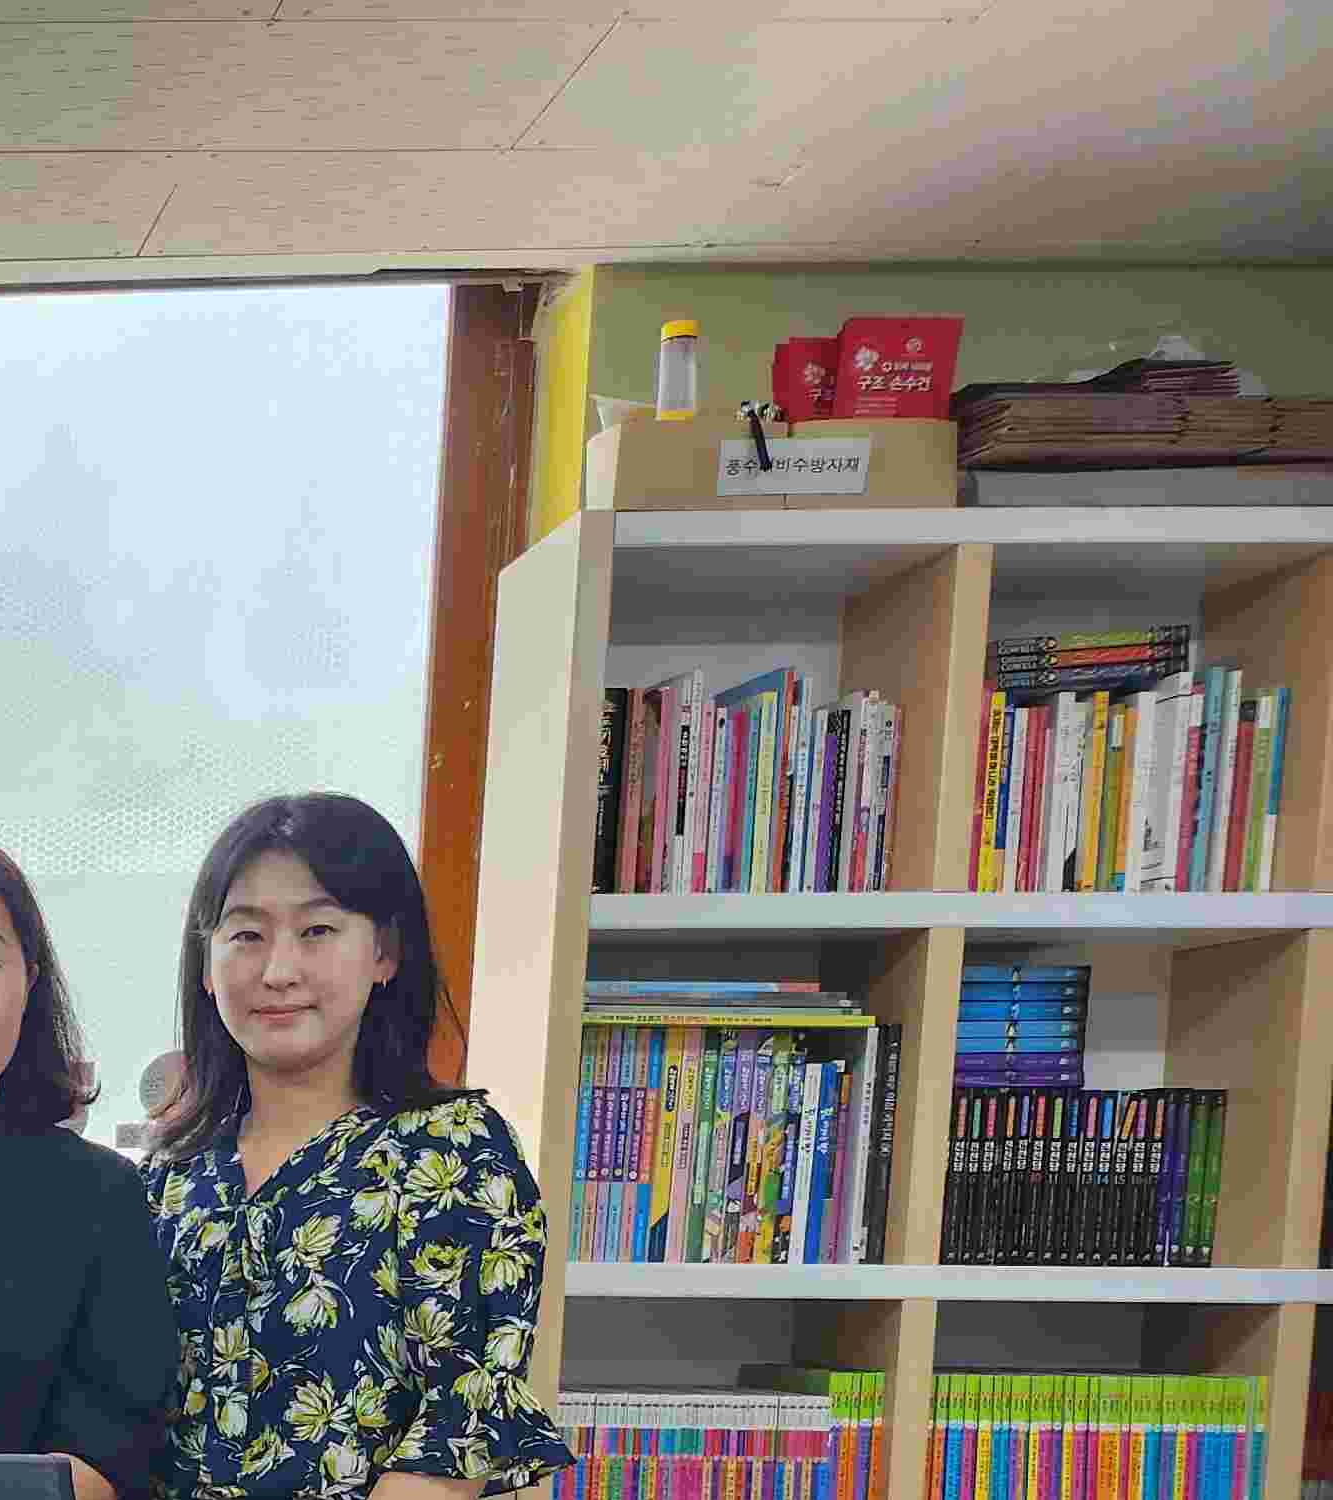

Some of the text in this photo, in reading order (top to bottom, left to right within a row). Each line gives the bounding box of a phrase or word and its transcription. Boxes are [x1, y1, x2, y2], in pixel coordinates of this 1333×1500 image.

[858, 376, 932, 391] 구조 손수건
[726, 456, 860, 476] 풍수비수방자재
